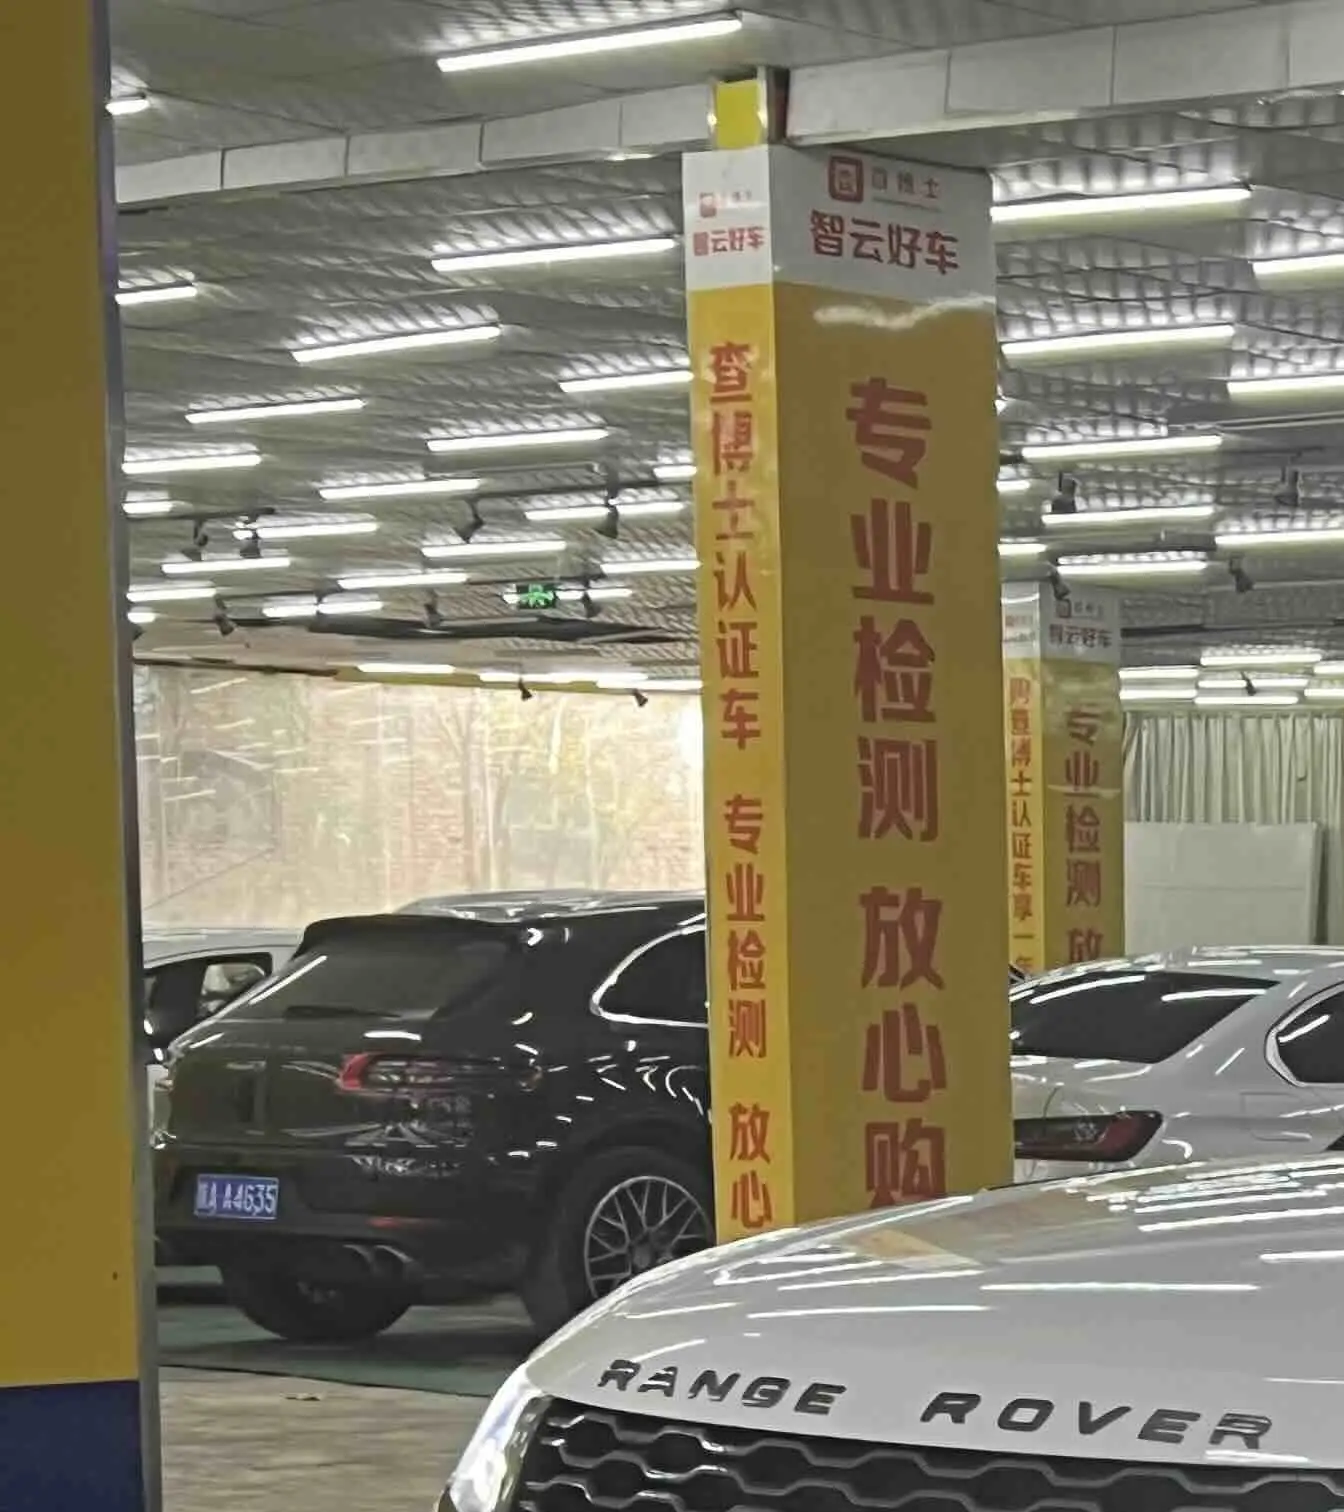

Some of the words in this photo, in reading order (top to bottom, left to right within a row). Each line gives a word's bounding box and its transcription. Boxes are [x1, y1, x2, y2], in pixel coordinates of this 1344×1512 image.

[811, 209, 959, 275] 智云好车
[708, 341, 762, 750] 查博士认证车
[845, 376, 939, 842] 专业检测
[1064, 706, 1103, 907] 专业检测
[723, 795, 767, 1059] 专业检测
[858, 886, 947, 1209] 放心购
[729, 1103, 773, 1229] 放心
[597, 1359, 847, 1416] RANGE
[919, 1391, 1272, 1450] ROVER
